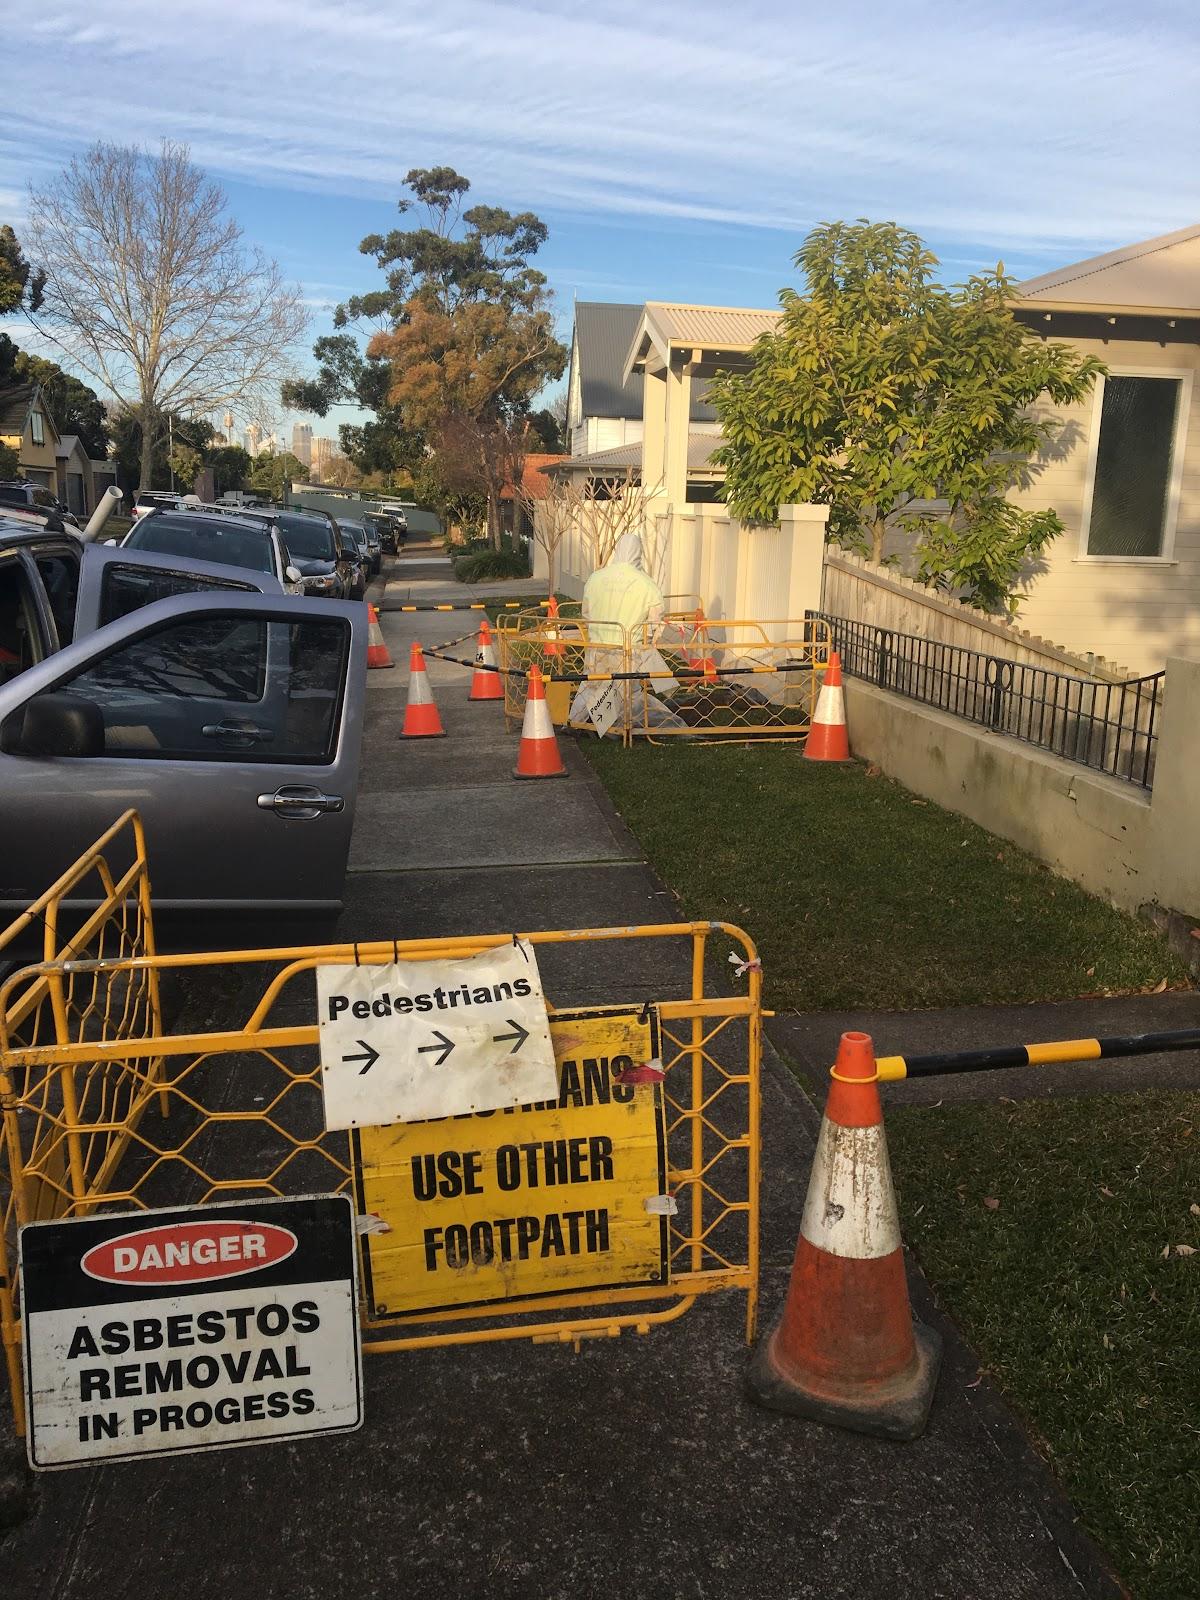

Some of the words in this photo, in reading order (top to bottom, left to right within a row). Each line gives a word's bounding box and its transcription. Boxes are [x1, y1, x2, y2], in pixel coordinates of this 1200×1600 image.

[590, 679, 616, 716] Pedestria
[328, 977, 532, 1021] Pedestrians
[411, 1150, 484, 1201] USE
[496, 1135, 614, 1191] OTHER
[113, 1233, 267, 1273] DANGER
[424, 1208, 610, 1272] FOOTPATH
[66, 1300, 321, 1360] ASBESTOS
[80, 1345, 311, 1402] REMOVAL
[79, 1412, 119, 1442] IN
[133, 1388, 315, 1436] PROGESS
